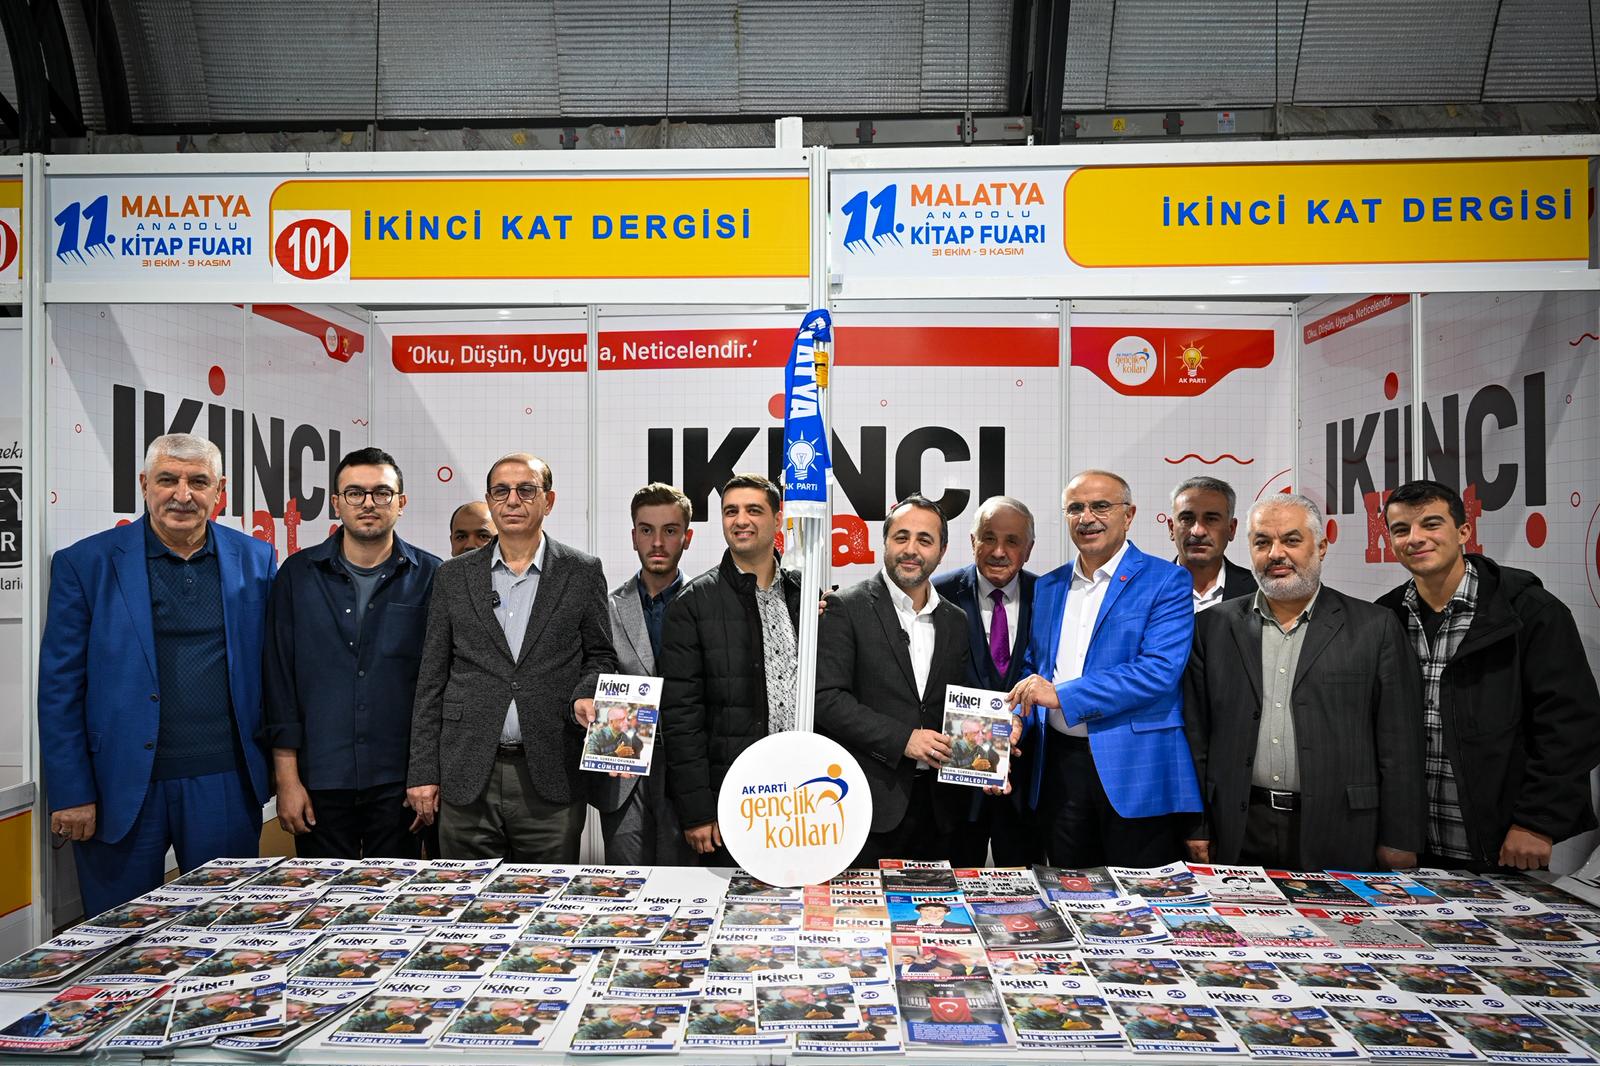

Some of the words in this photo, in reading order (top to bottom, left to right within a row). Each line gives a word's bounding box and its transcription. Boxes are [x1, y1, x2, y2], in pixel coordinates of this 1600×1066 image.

[910, 183, 1045, 206] MALATYA
[121, 195, 251, 218] MALATYA
[926, 210, 1031, 219] ANADOLU
[1163, 194, 1285, 227] İKİNCİ
[1307, 199, 1381, 225] KAT
[1403, 189, 1572, 223] DERGİSİ
[136, 222, 238, 231] ANADOLU
[364, 210, 481, 241] İKİNCİ
[502, 215, 573, 240] KAT
[592, 208, 751, 240] DERGİSİ
[910, 222, 974, 245] KİTAP
[980, 224, 1045, 244] FUARI
[121, 233, 183, 256] KİTAP
[189, 234, 252, 256] FUARI
[288, 227, 337, 272] 101
[931, 248, 943, 257] 31
[944, 247, 971, 256] EKİM
[979, 248, 987, 256] 9
[988, 248, 1024, 256] KASIM
[154, 258, 181, 267] EKİM
[187, 259, 195, 267] 9
[196, 258, 232, 267] KASIM
[461, 344, 527, 367] Düşün,
[789, 331, 818, 419] ATYA
[598, 762, 630, 771] CÜMLEDİR
[742, 786, 756, 795] AK
[758, 782, 787, 794] PARTİ
[956, 776, 988, 784] CÜMLEDİR
[741, 786, 816, 831] gençlik
[765, 816, 838, 849] kolları
